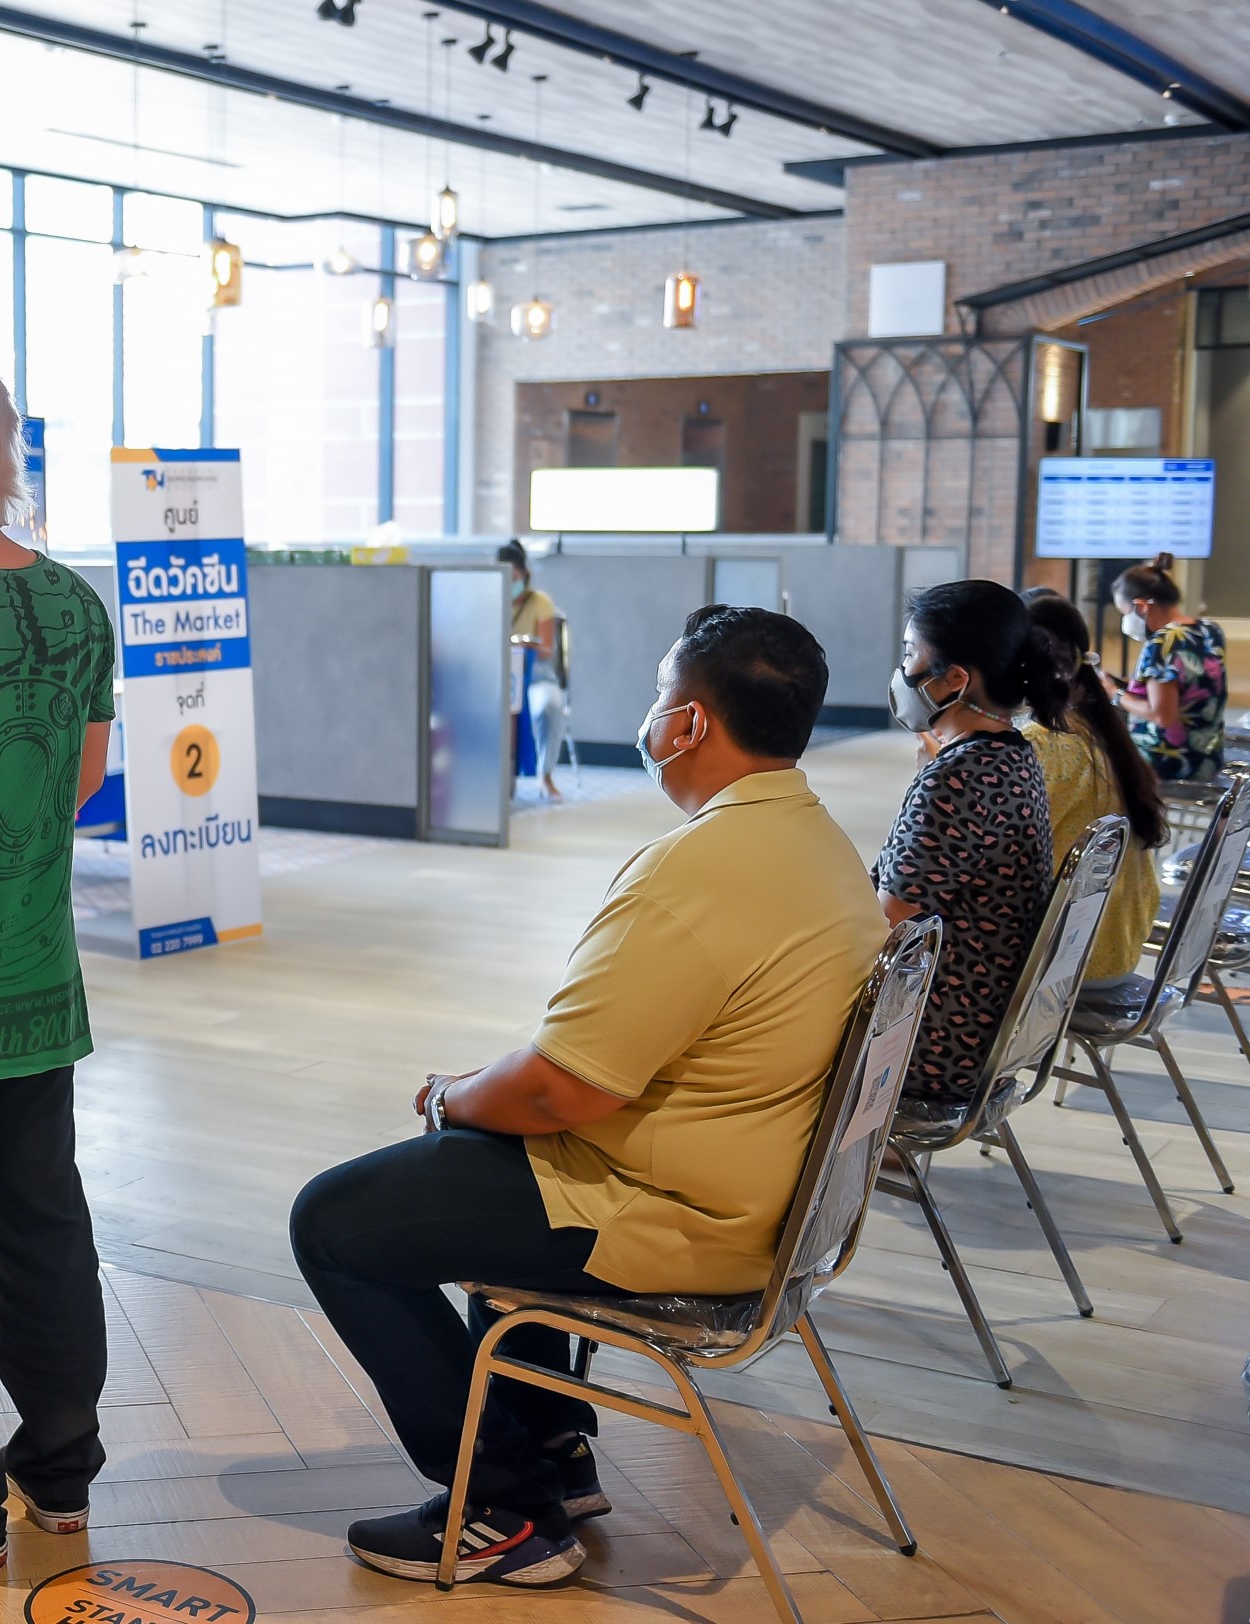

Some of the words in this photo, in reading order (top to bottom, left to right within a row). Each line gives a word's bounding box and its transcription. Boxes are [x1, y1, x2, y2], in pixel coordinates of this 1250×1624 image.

[164, 499, 199, 533] ศูนย์
[126, 553, 239, 598] ฉีดวัคซีน
[131, 610, 166, 636] The
[174, 606, 241, 633] Market
[185, 743, 204, 779] 2
[140, 813, 252, 859] ลงทะเบียน
[85, 1569, 240, 1622] SMART
